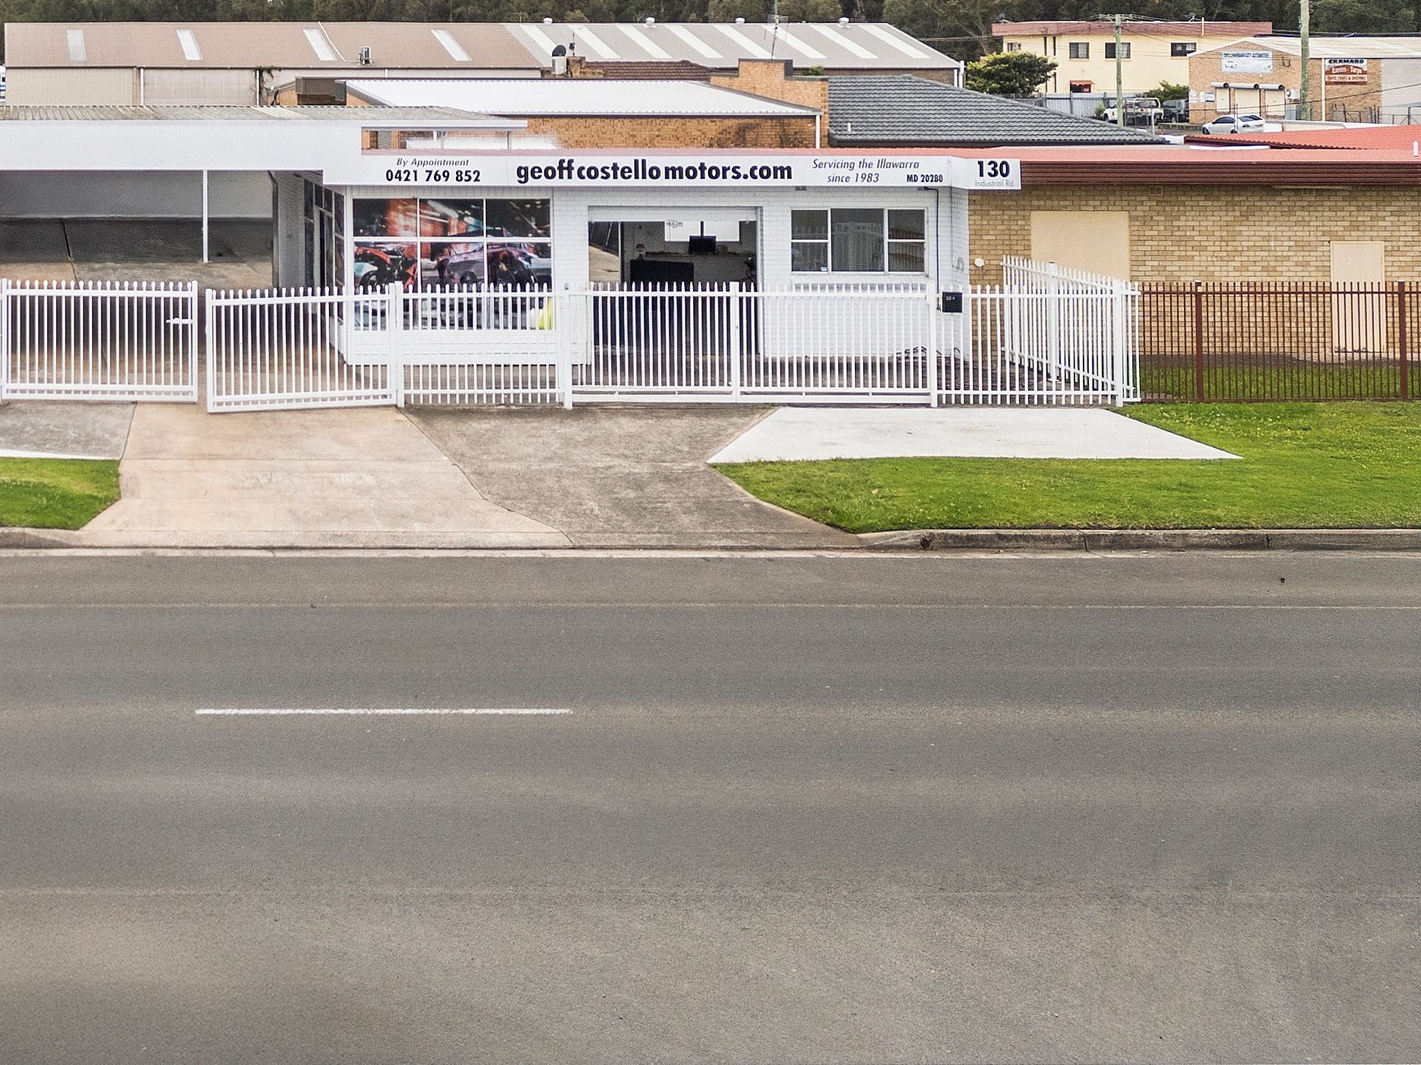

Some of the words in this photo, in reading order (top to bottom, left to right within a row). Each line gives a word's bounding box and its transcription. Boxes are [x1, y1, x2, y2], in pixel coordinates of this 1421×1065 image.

[396, 158, 409, 167] By
[411, 158, 470, 168] Appointment
[812, 158, 855, 171] Servicing
[858, 158, 874, 169] the
[876, 158, 920, 169] Illawarra
[977, 160, 1011, 178] 130
[386, 169, 418, 182] 0421
[425, 169, 450, 182] 769
[455, 169, 481, 182] 852
[827, 172, 851, 183] since
[855, 173, 880, 183] 1983
[906, 174, 919, 183] MD
[920, 174, 944, 183] 20280
[975, 179, 1004, 188] Industrial
[1006, 179, 1014, 187] Rd
